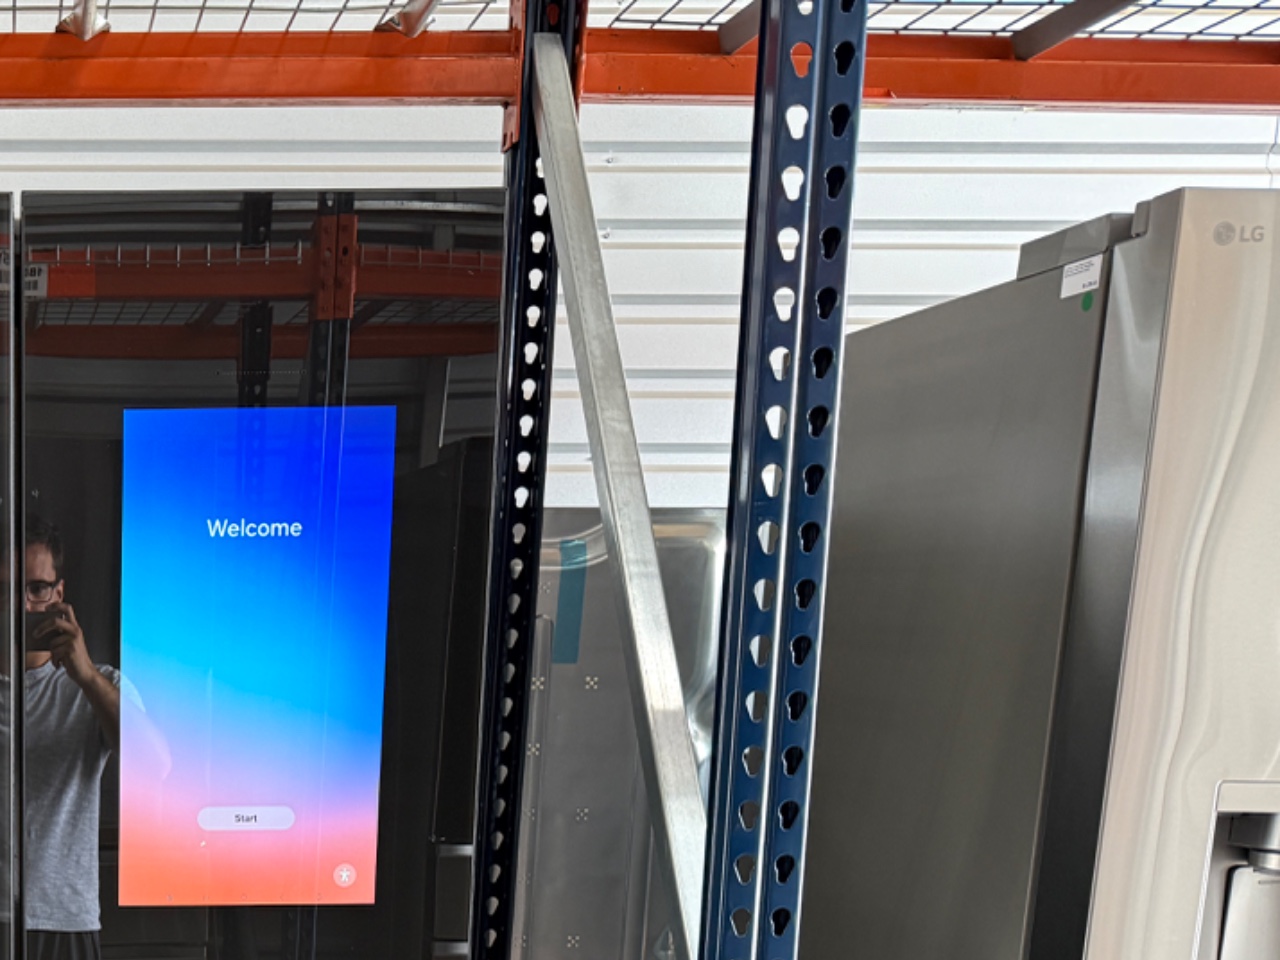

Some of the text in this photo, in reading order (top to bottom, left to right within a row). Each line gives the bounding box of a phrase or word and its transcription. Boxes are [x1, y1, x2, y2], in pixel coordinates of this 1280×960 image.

[1239, 225, 1265, 243] LG
[207, 518, 302, 537] Welcome
[234, 814, 257, 823] Start
